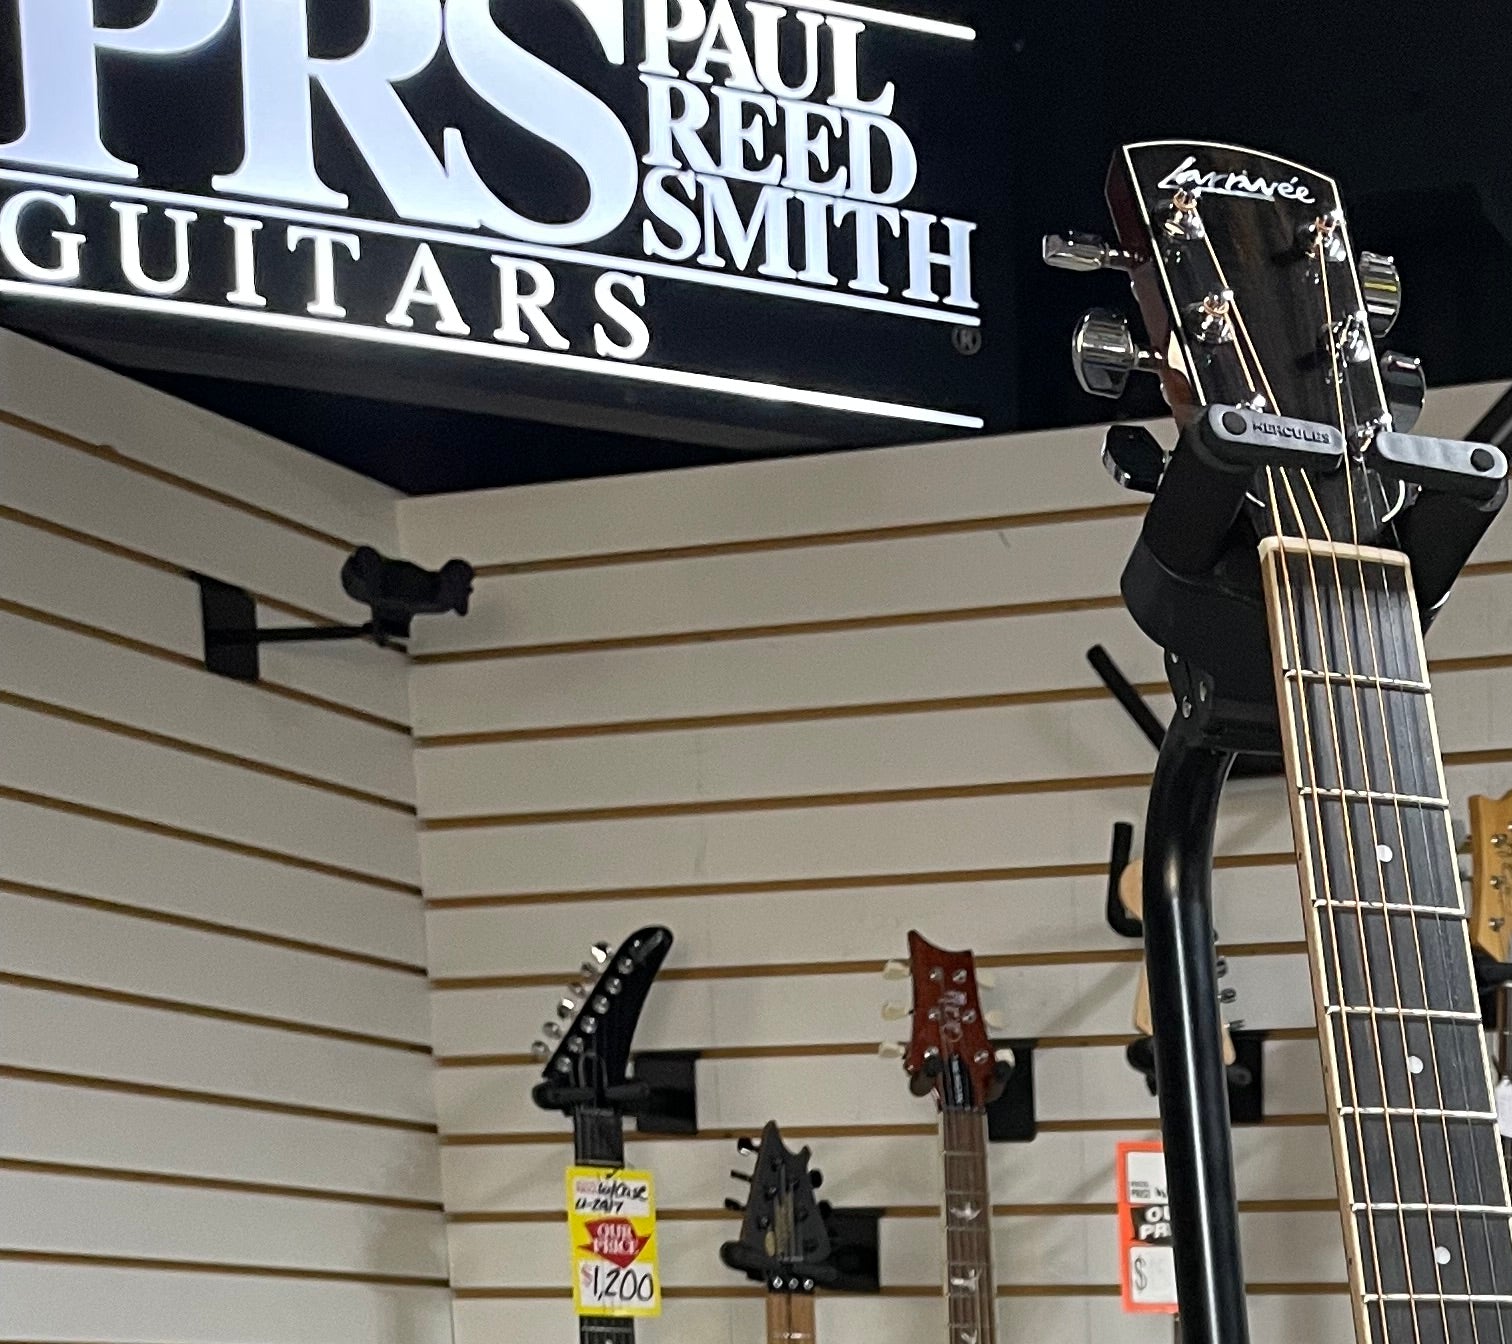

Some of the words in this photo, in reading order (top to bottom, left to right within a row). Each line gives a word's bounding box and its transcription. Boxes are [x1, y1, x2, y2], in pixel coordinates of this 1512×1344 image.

[638, 0, 894, 116] PAUL
[0, 0, 639, 246] PRS
[640, 74, 918, 206] REED
[0, 190, 652, 361] GUITARS
[642, 168, 980, 310] SMITH
[1252, 421, 1331, 445] HERCULES
[592, 1236, 640, 1257] PRICE
[596, 1221, 633, 1240] OUR
